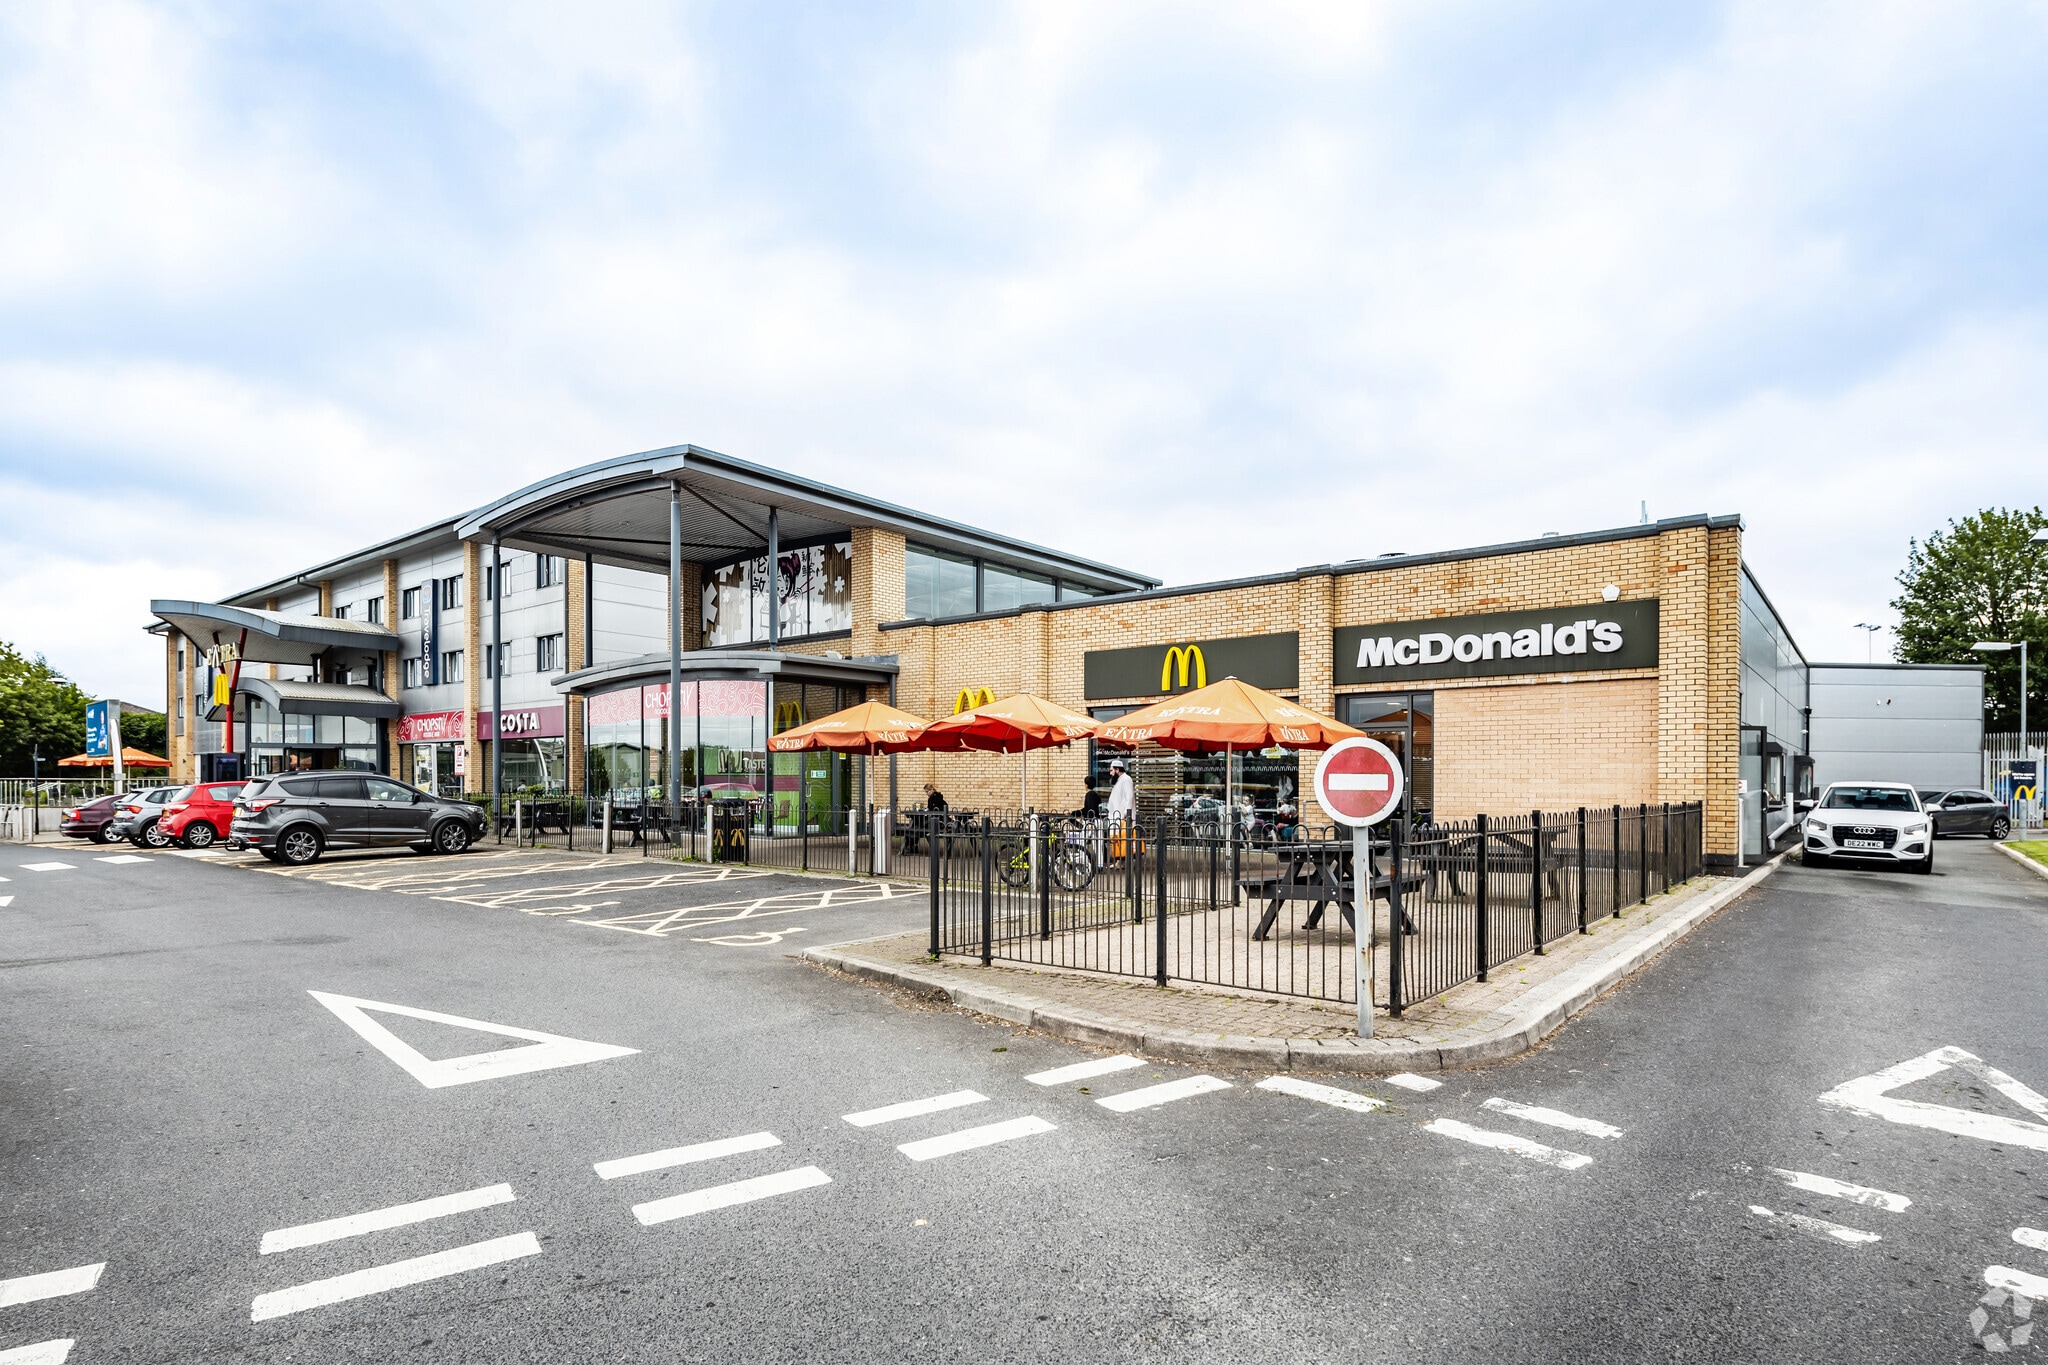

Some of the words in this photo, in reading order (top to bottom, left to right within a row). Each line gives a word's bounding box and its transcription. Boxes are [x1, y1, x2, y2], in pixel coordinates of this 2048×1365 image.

[422, 605, 431, 678] Travelodge
[1356, 619, 1624, 668] McDonald's
[1158, 706, 1221, 717] EXTRA
[501, 712, 540, 733] COSTA
[1105, 726, 1153, 740] EXTRA
[776, 738, 804, 749] EXTRA
